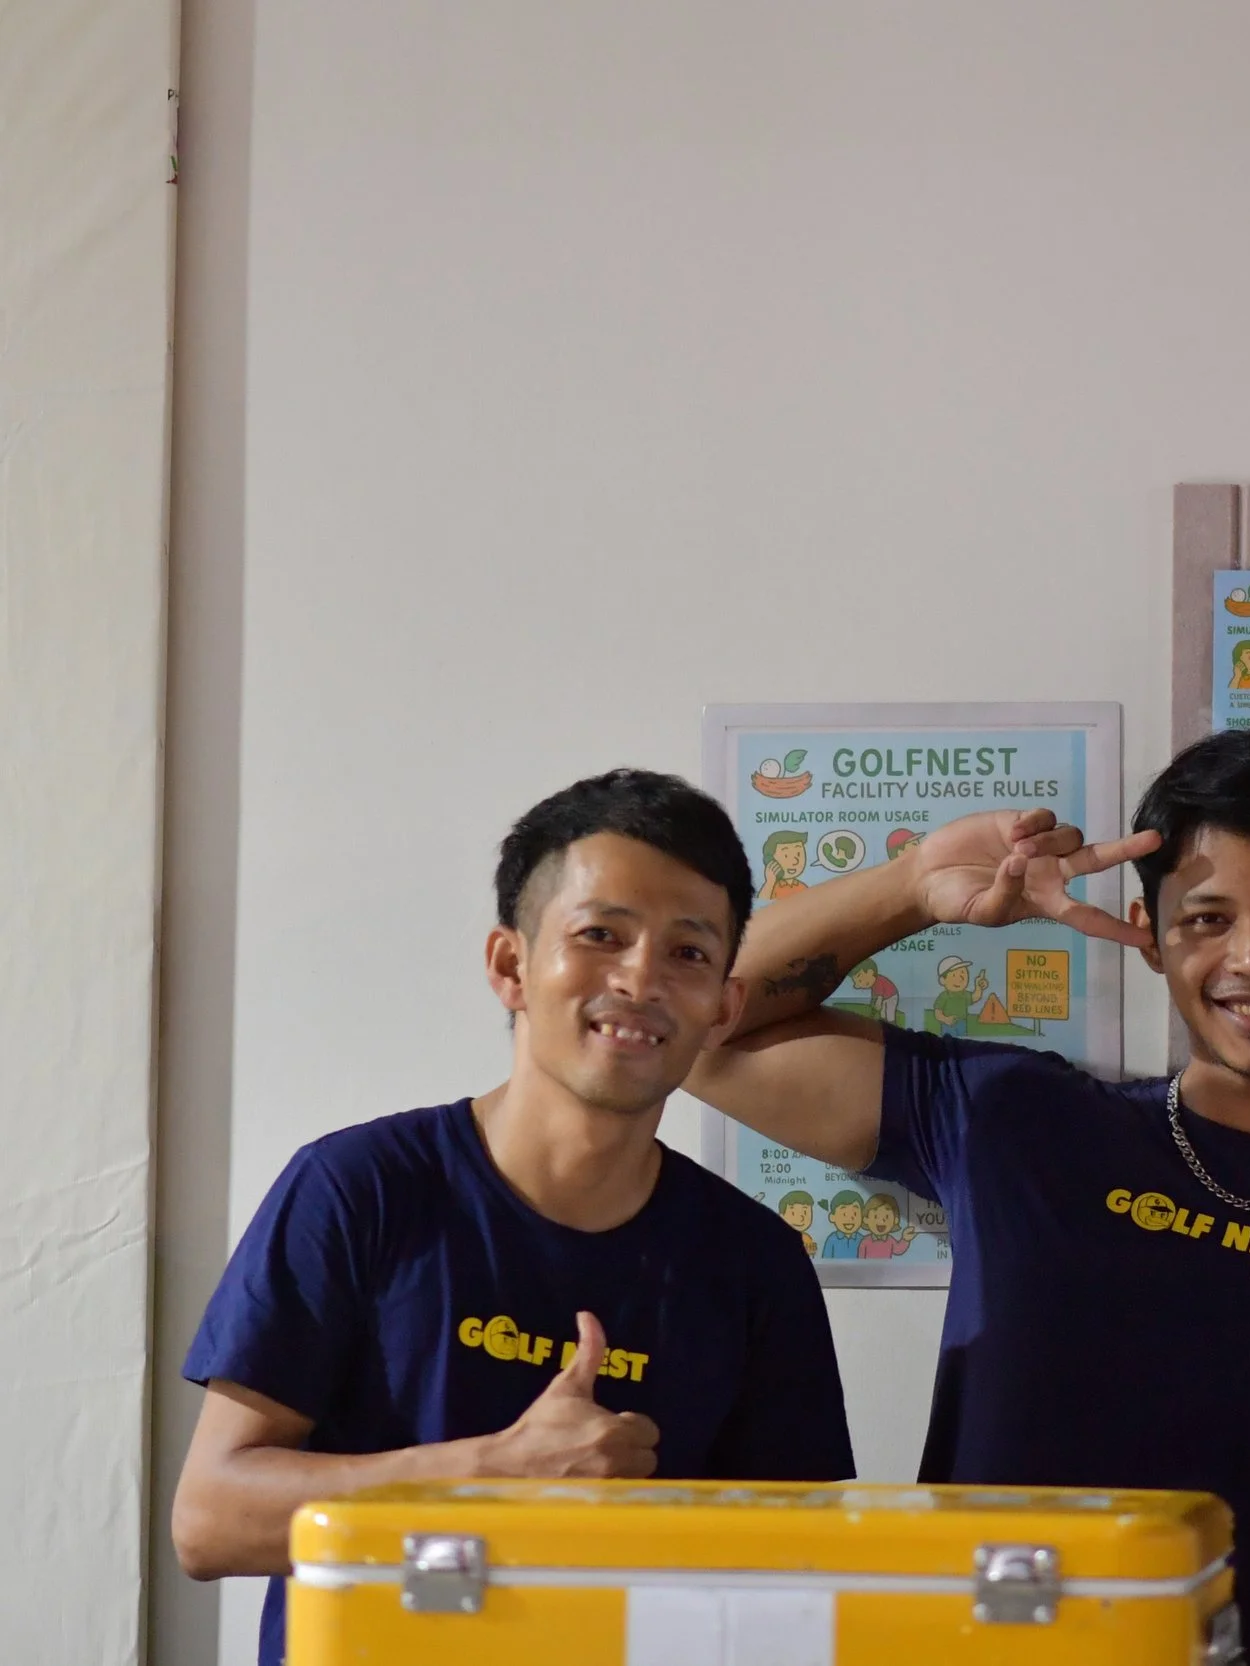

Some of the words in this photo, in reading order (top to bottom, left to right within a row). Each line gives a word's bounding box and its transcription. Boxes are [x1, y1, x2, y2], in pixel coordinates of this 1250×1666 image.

[832, 747, 1018, 778] GOLFNEST
[821, 782, 909, 799] FACILITY
[915, 782, 984, 798] USAGE
[993, 780, 1058, 797] RULES
[755, 811, 834, 824] SIMULATOR
[838, 811, 880, 823] ROOM
[884, 810, 929, 823] USAGE
[932, 926, 962, 936] BALLS
[1026, 955, 1047, 966] NO
[1015, 969, 1059, 980] SITTING
[1017, 992, 1057, 1003] BEYOND
[1012, 1003, 1031, 1013] RED
[1035, 1005, 1063, 1015] LINES
[762, 1149, 789, 1159] 8:00
[760, 1163, 791, 1173] 12:00
[764, 1176, 807, 1186] Midnight
[916, 1212, 945, 1225] YOU
[1106, 1188, 1215, 1239] GOLF
[458, 1315, 554, 1366] GOLF
